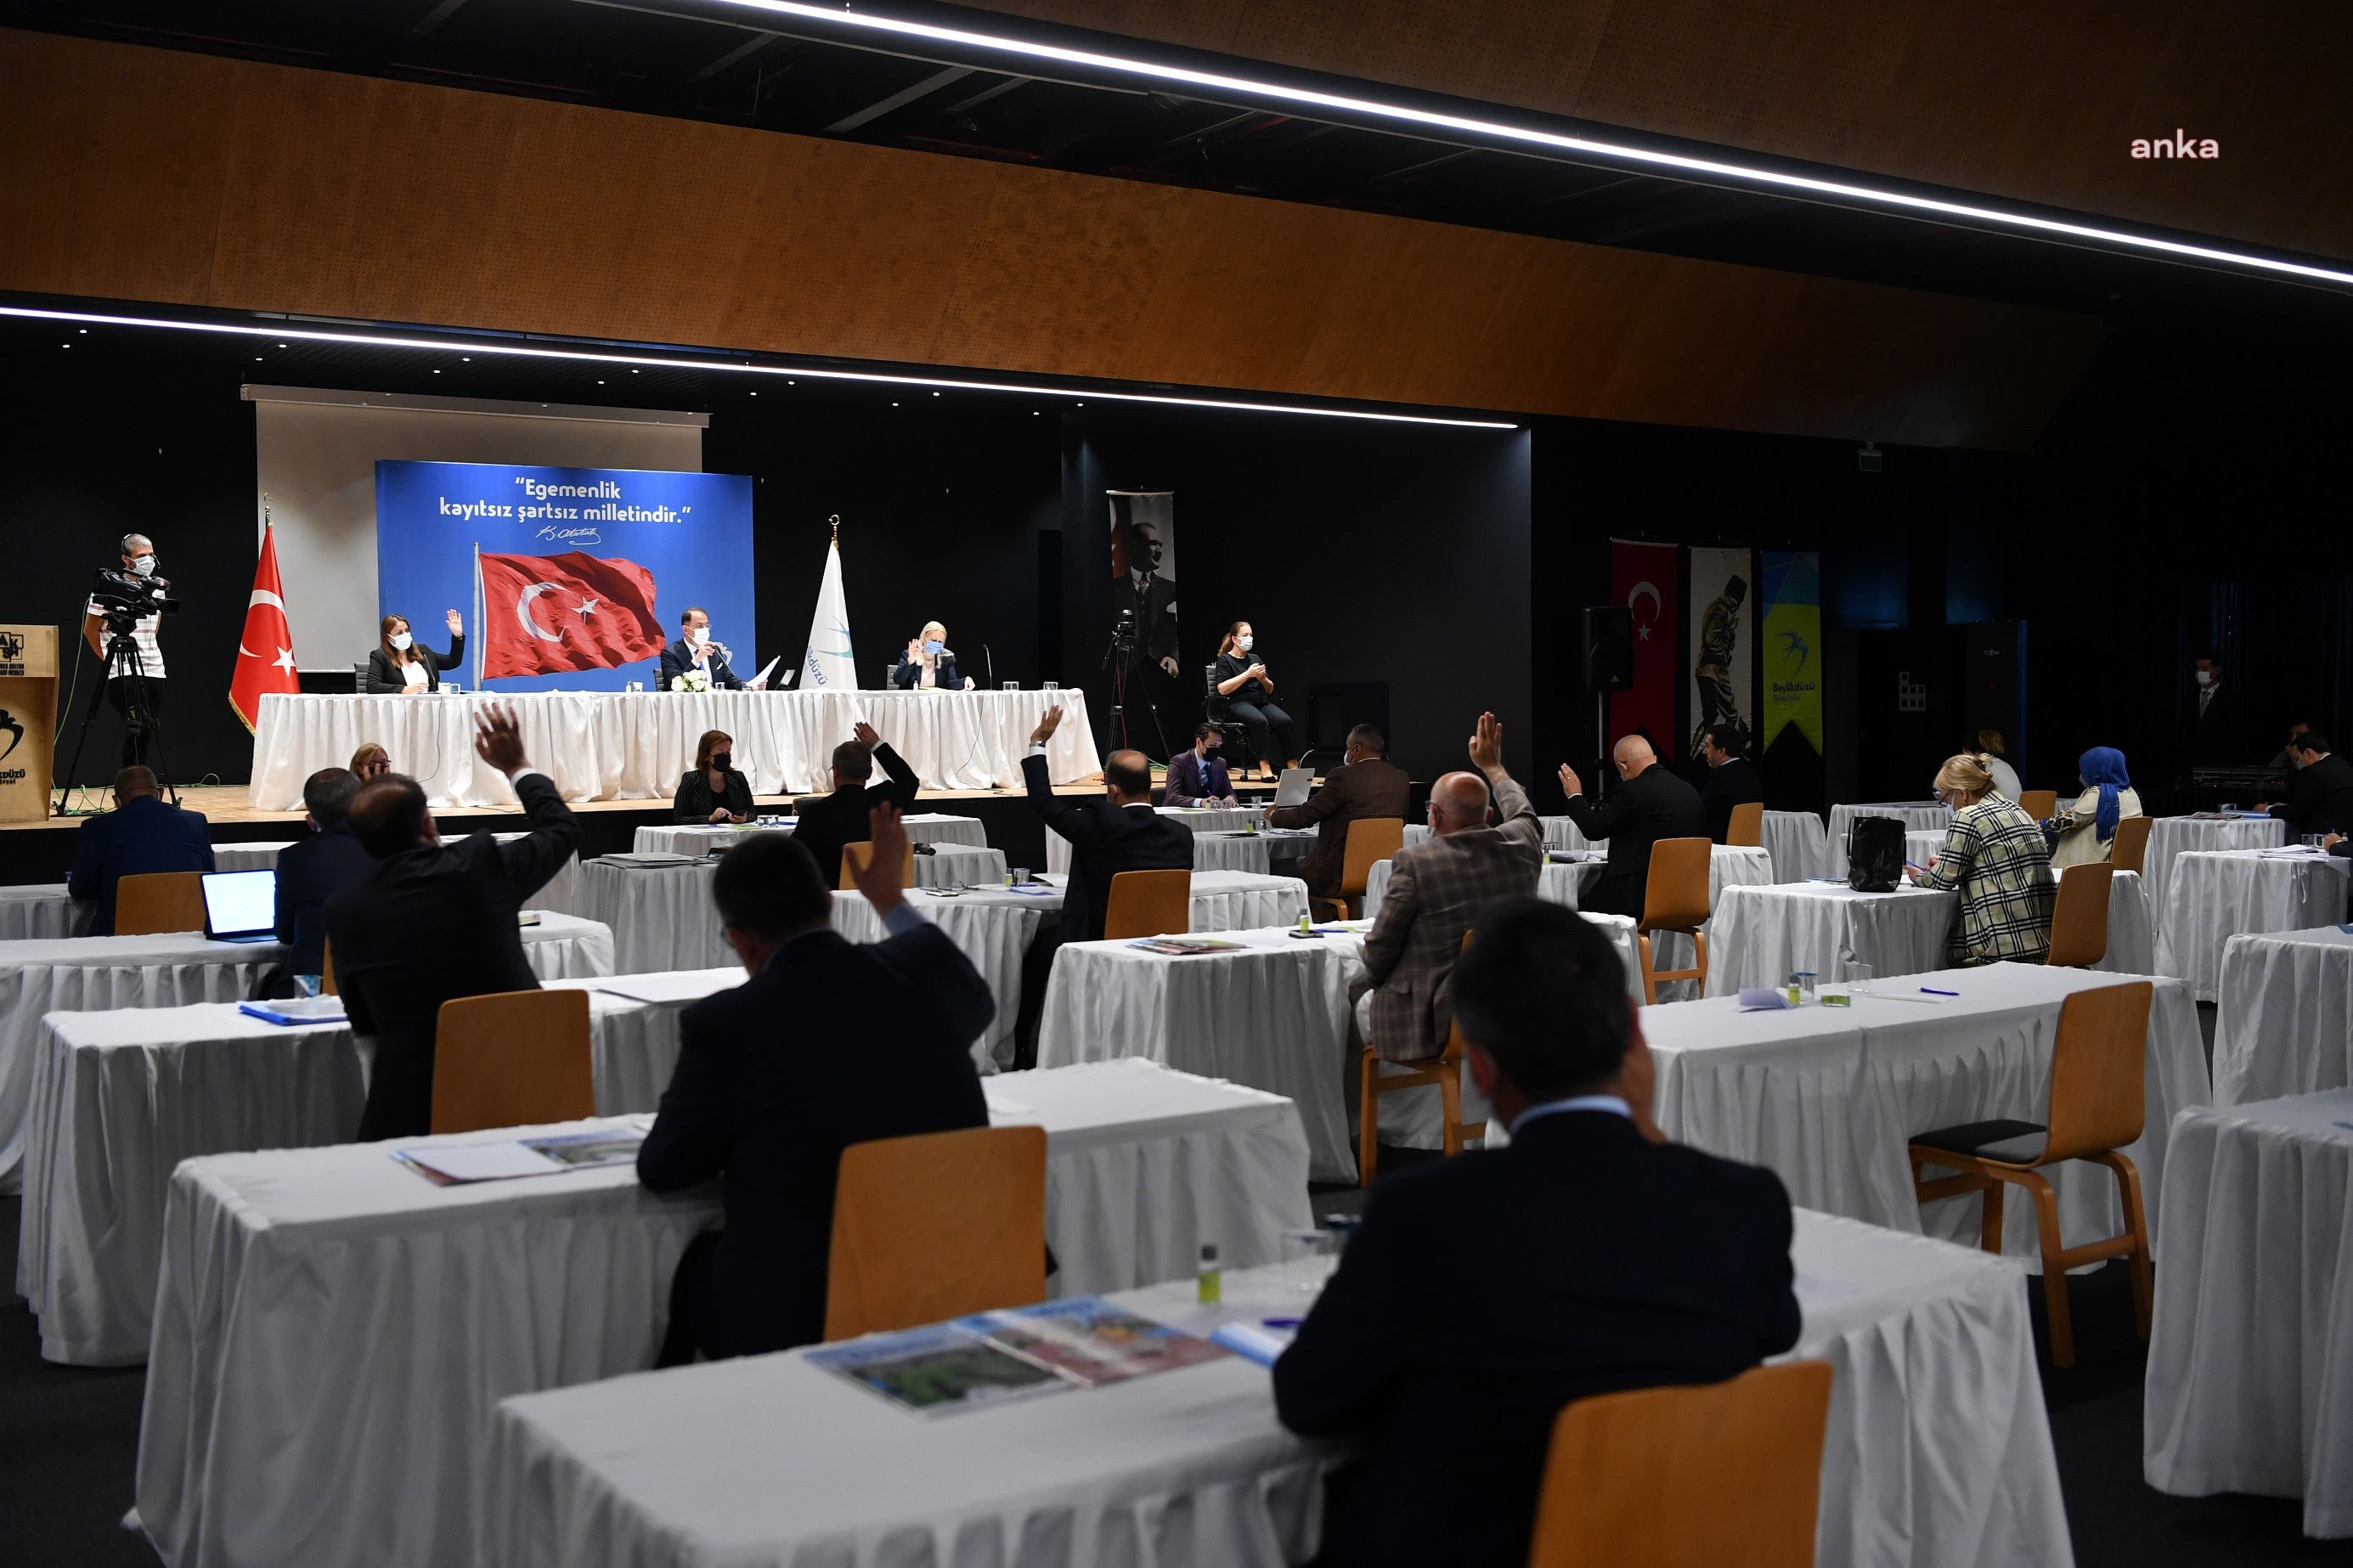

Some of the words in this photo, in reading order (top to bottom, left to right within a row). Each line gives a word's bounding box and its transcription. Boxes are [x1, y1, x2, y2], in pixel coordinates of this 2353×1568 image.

[515, 477, 622, 501] “Egemenlik
[439, 497, 513, 521] kayıtsız
[517, 502, 578, 523] şartsız
[1773, 680, 1815, 694] Beylikdüzü
